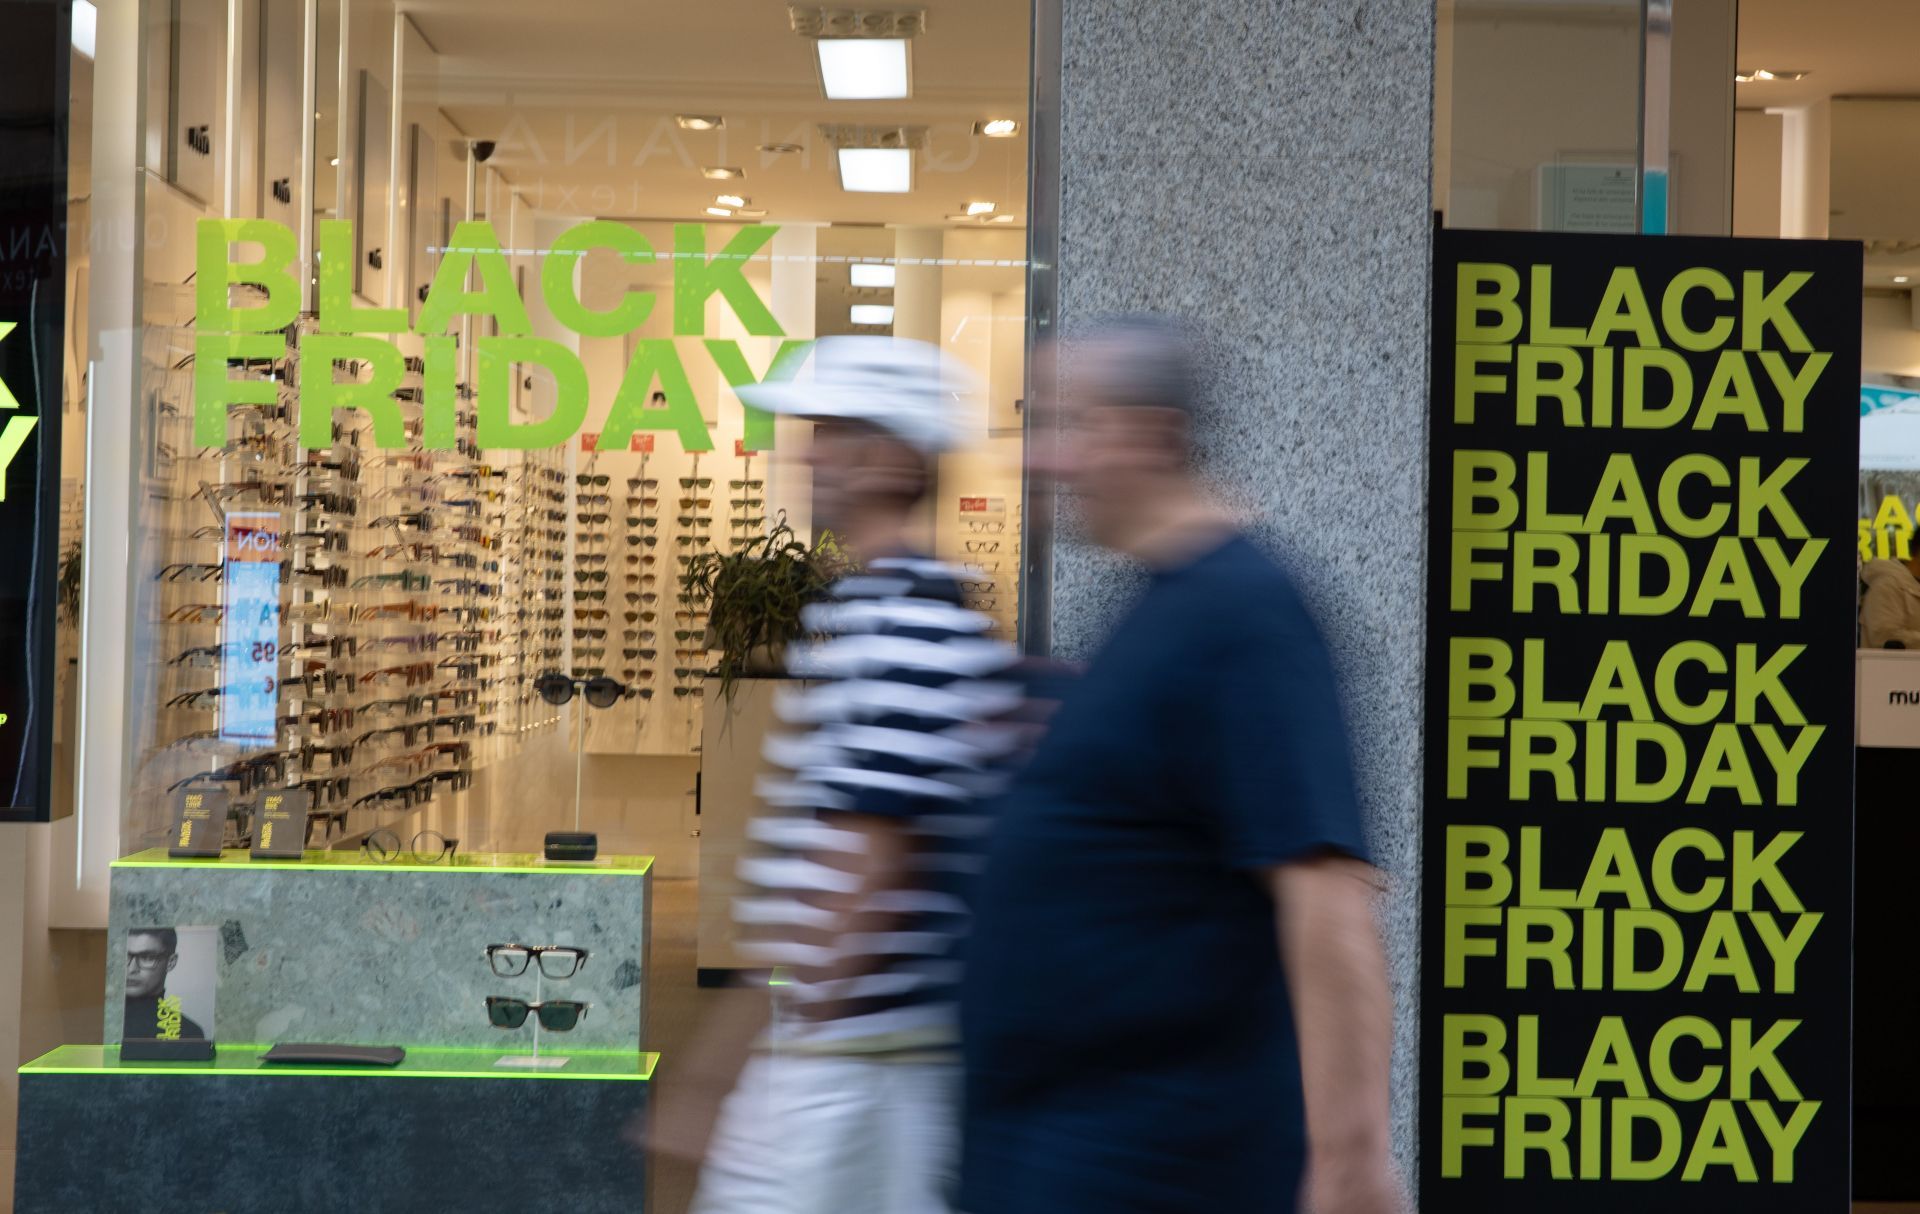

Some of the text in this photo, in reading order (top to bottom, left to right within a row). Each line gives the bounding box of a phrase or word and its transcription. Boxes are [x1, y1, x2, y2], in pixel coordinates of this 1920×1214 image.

[195, 218, 787, 337] BLACK
[1454, 262, 1816, 352] BLACK
[195, 333, 817, 450] FRIDAY
[1453, 345, 1833, 432] FRIDAY
[1451, 450, 1812, 538] BLACK
[1450, 532, 1829, 619] FRIDAY
[1448, 637, 1808, 725] BLACK
[1446, 719, 1825, 806] FRIDAY
[1445, 825, 1806, 913] BLACK
[1443, 907, 1824, 993] FRIDAY
[1443, 1014, 1804, 1102] BLACK
[1441, 1096, 1822, 1184] FRIDAY
